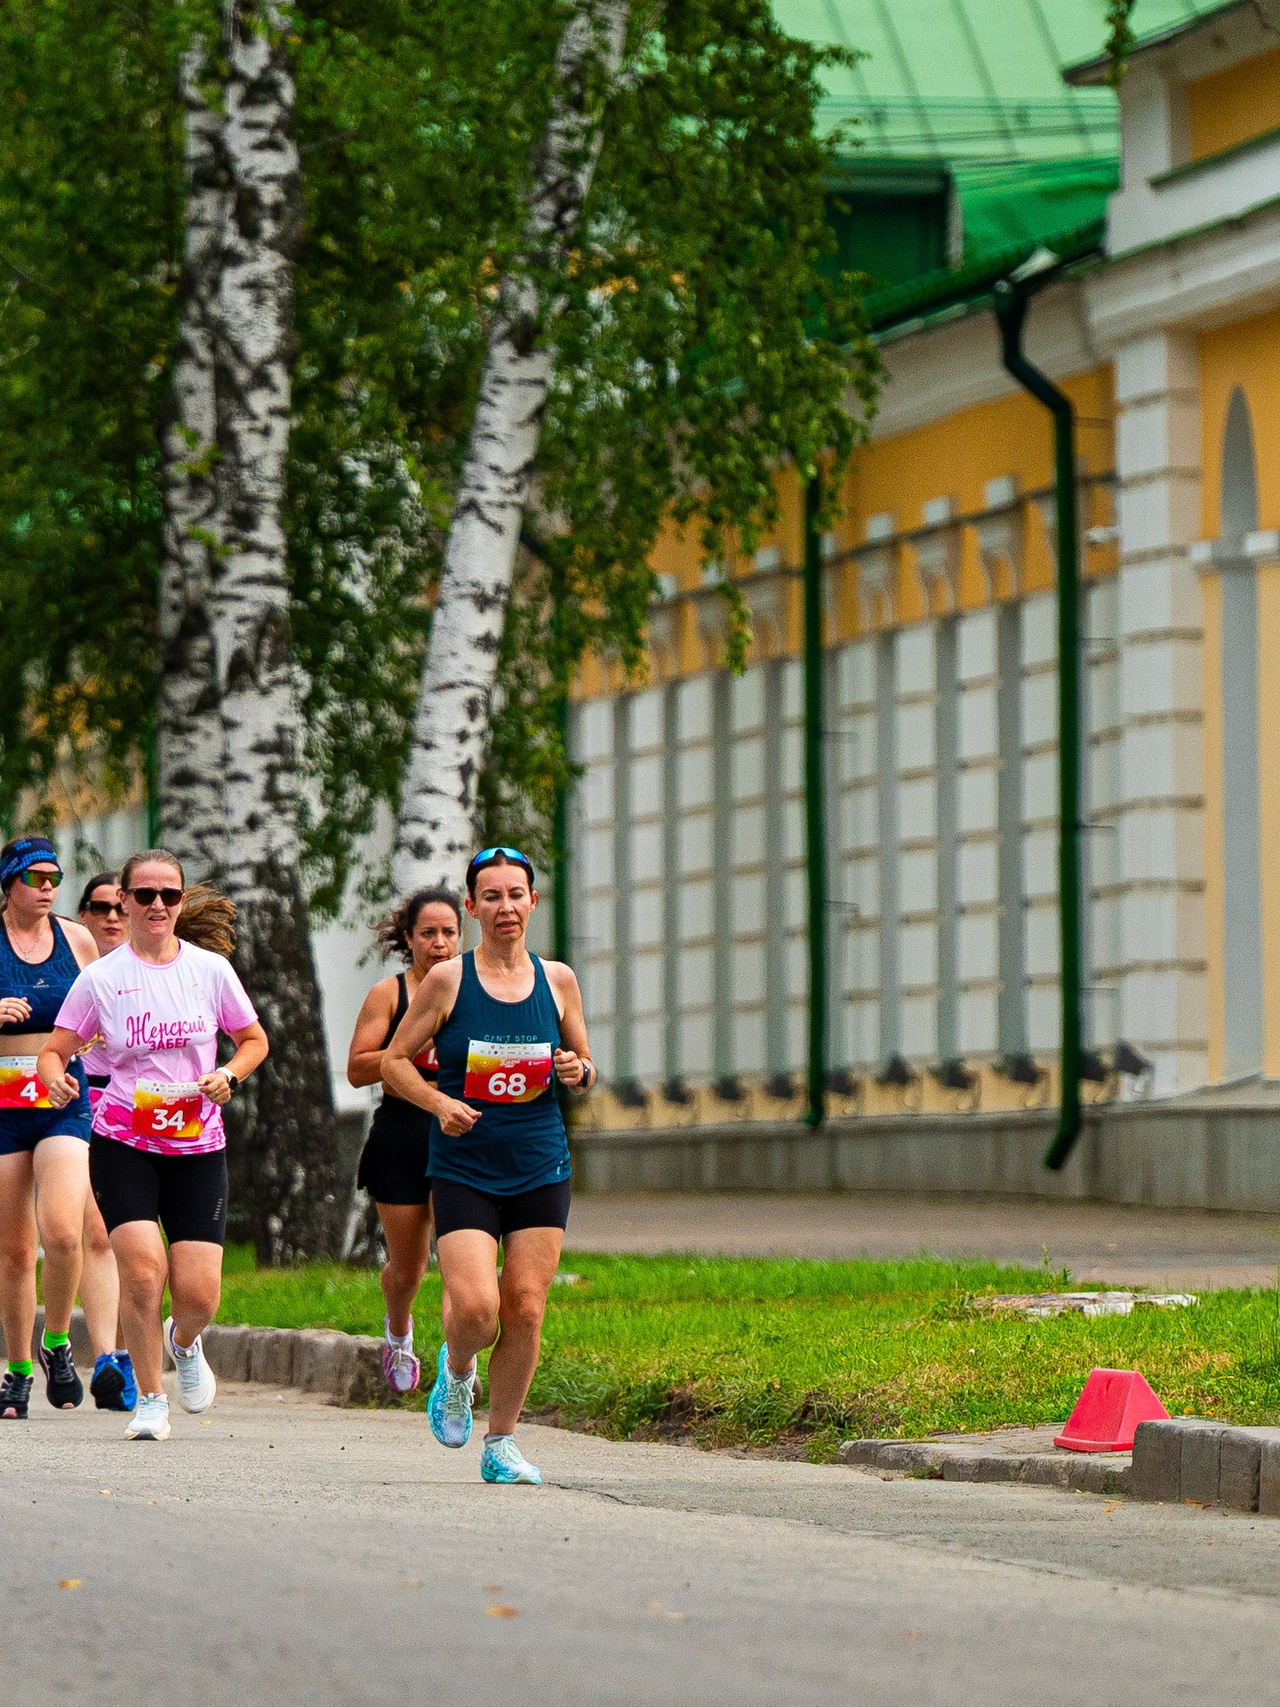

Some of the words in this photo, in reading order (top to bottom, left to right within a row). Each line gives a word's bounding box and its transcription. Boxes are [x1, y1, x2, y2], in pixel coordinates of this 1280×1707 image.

[126, 1011, 207, 1048] Женский
[483, 1034, 511, 1042] CAN'T
[514, 1034, 538, 1042] STOP
[148, 1038, 191, 1051] ЗАБЕГ
[20, 1081, 39, 1102] 4
[488, 1072, 527, 1096] 68
[151, 1108, 185, 1131] 34
